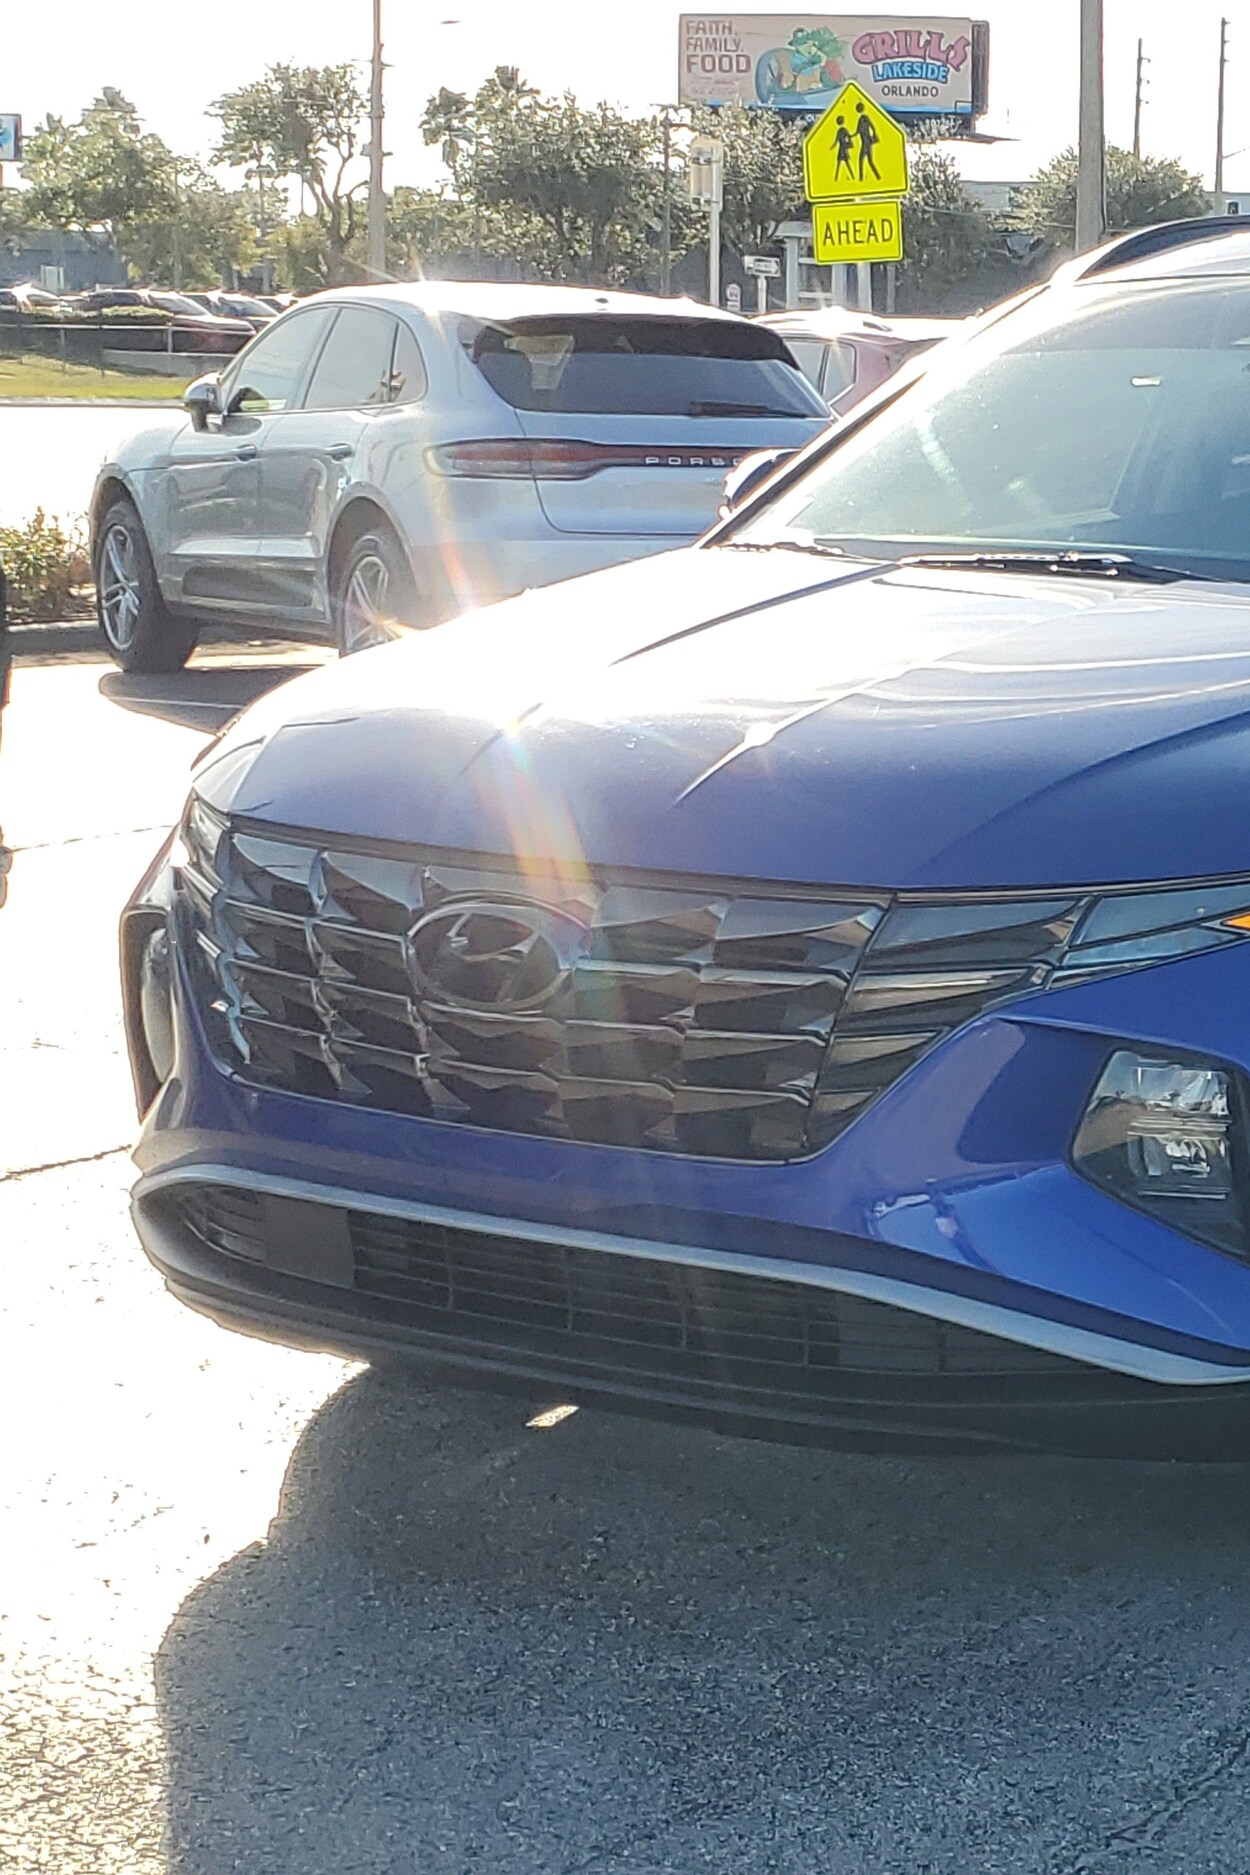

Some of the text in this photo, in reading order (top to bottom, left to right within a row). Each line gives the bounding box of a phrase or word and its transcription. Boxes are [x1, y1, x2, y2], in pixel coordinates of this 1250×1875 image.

[852, 29, 970, 72] GRILLS
[686, 54, 751, 73] FOOD
[871, 60, 950, 84] LAKESIDE
[881, 85, 939, 97] ORLANDO
[823, 218, 893, 246] AHEAD
